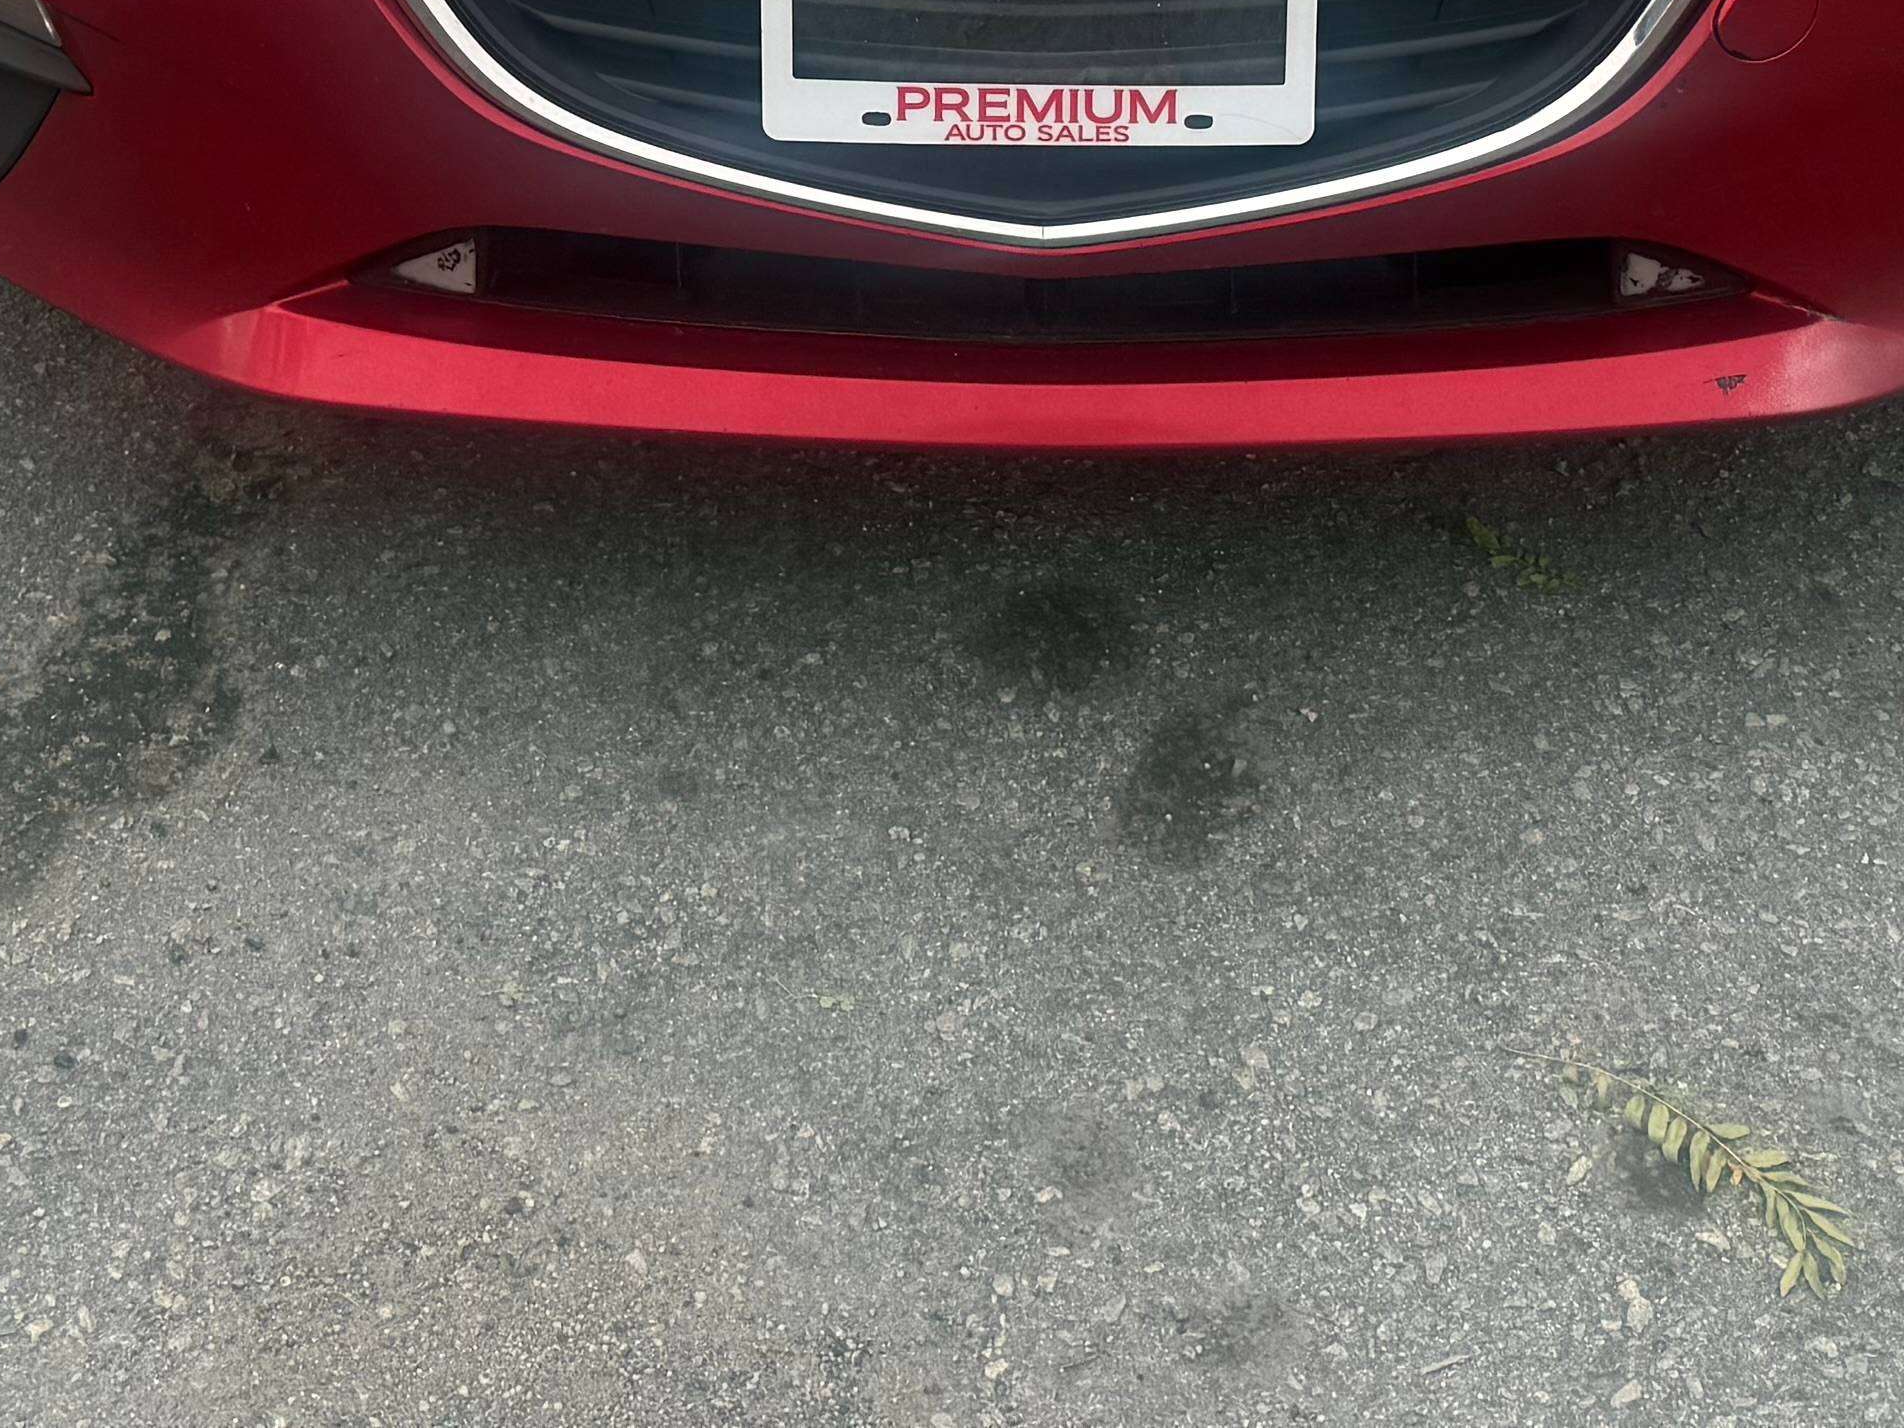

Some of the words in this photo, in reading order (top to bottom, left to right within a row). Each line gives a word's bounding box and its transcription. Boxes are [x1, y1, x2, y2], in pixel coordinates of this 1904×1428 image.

[895, 86, 1179, 126] PREMIUM
[944, 123, 1026, 142] AUTO
[1037, 124, 1131, 143] SALES
